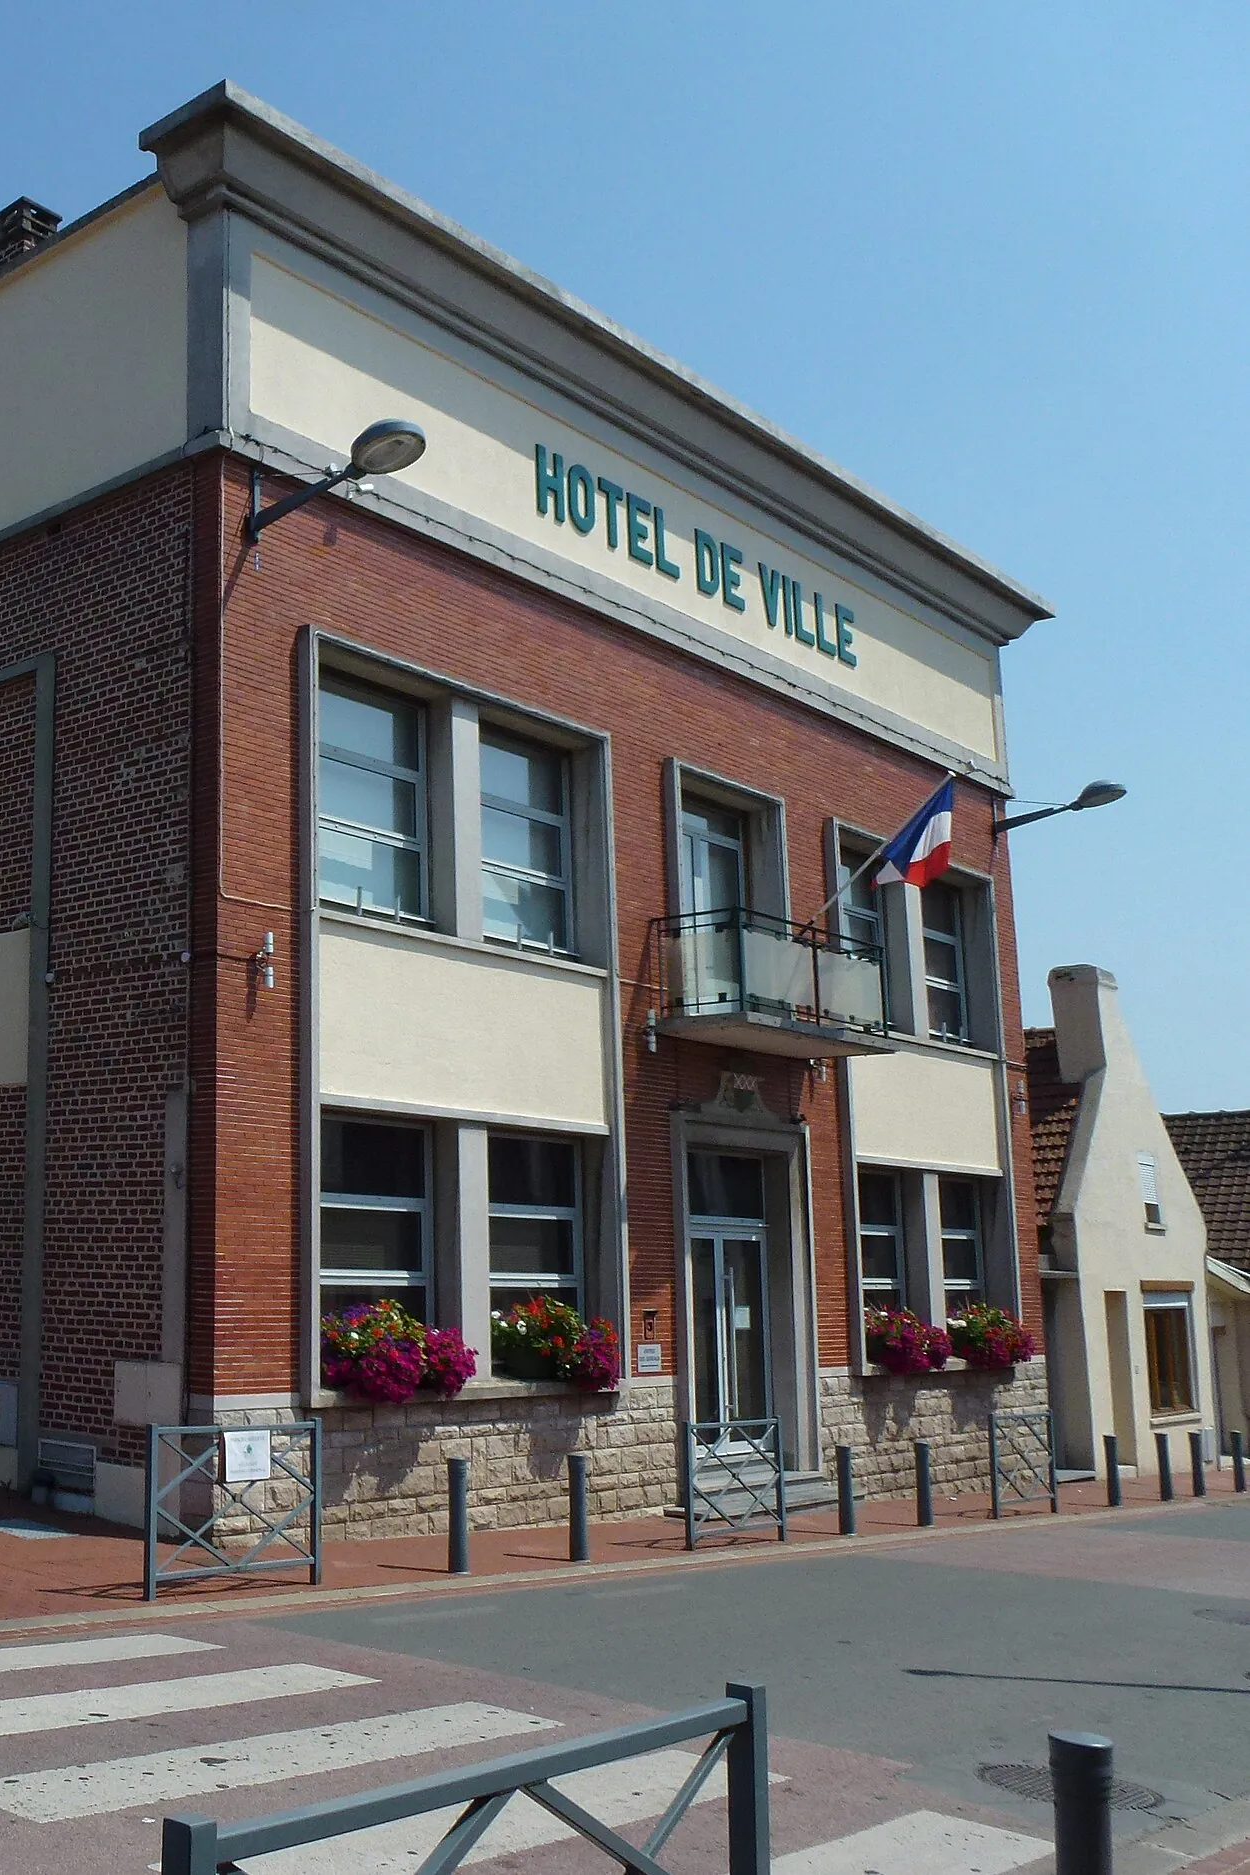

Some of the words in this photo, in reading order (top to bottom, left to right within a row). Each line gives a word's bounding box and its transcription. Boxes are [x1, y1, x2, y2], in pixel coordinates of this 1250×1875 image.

[535, 443, 681, 581] HOTEL
[694, 527, 746, 614] DE
[758, 561, 857, 669] VILLE
